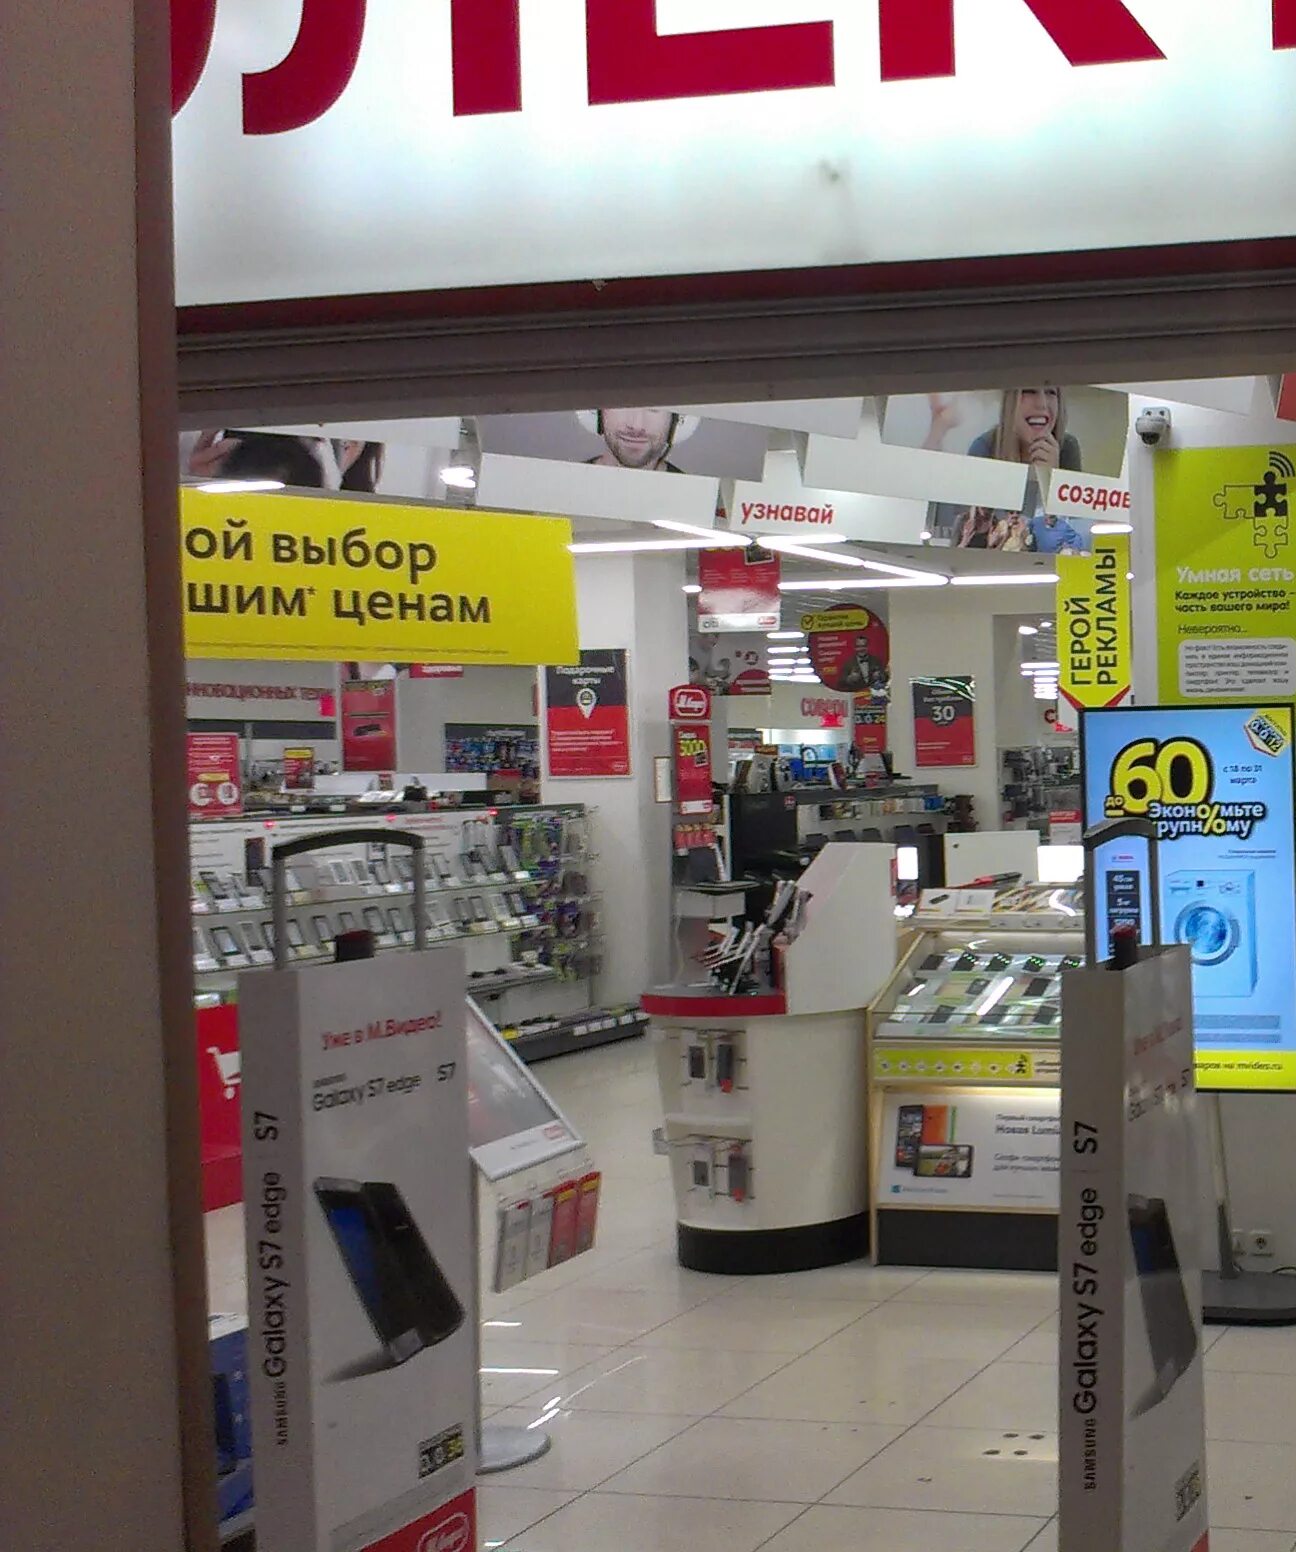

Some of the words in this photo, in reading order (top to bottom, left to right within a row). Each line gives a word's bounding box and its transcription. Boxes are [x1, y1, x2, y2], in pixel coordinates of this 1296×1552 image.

[741, 499, 835, 526] узнавай
[272, 527, 439, 585] выбор
[1176, 566, 1242, 584] Умная
[1247, 567, 1296, 582] сеть
[332, 588, 493, 627] ценам
[1174, 590, 1220, 601] Каждое
[1222, 588, 1287, 602] устройство
[1174, 603, 1208, 613] часть
[1209, 602, 1254, 613] вашего
[1255, 600, 1291, 613] мира!
[1096, 547, 1119, 686] РЕКЛАМЫ
[1069, 596, 1092, 686] ГЕРОЙ
[931, 706, 956, 722] 30
[1113, 738, 1211, 814] 60
[1105, 796, 1124, 807] до
[312, 1084, 366, 1112] Galaxy
[436, 1061, 457, 1082] S7
[254, 1110, 279, 1141] S7
[1073, 1120, 1099, 1155] S7
[260, 1171, 288, 1235] edge
[1081, 1188, 1104, 1256] edge
[258, 1239, 284, 1270] S7
[1073, 1263, 1099, 1297] S7
[262, 1276, 291, 1379] Galaxy
[1073, 1304, 1105, 1416] Galaxy
